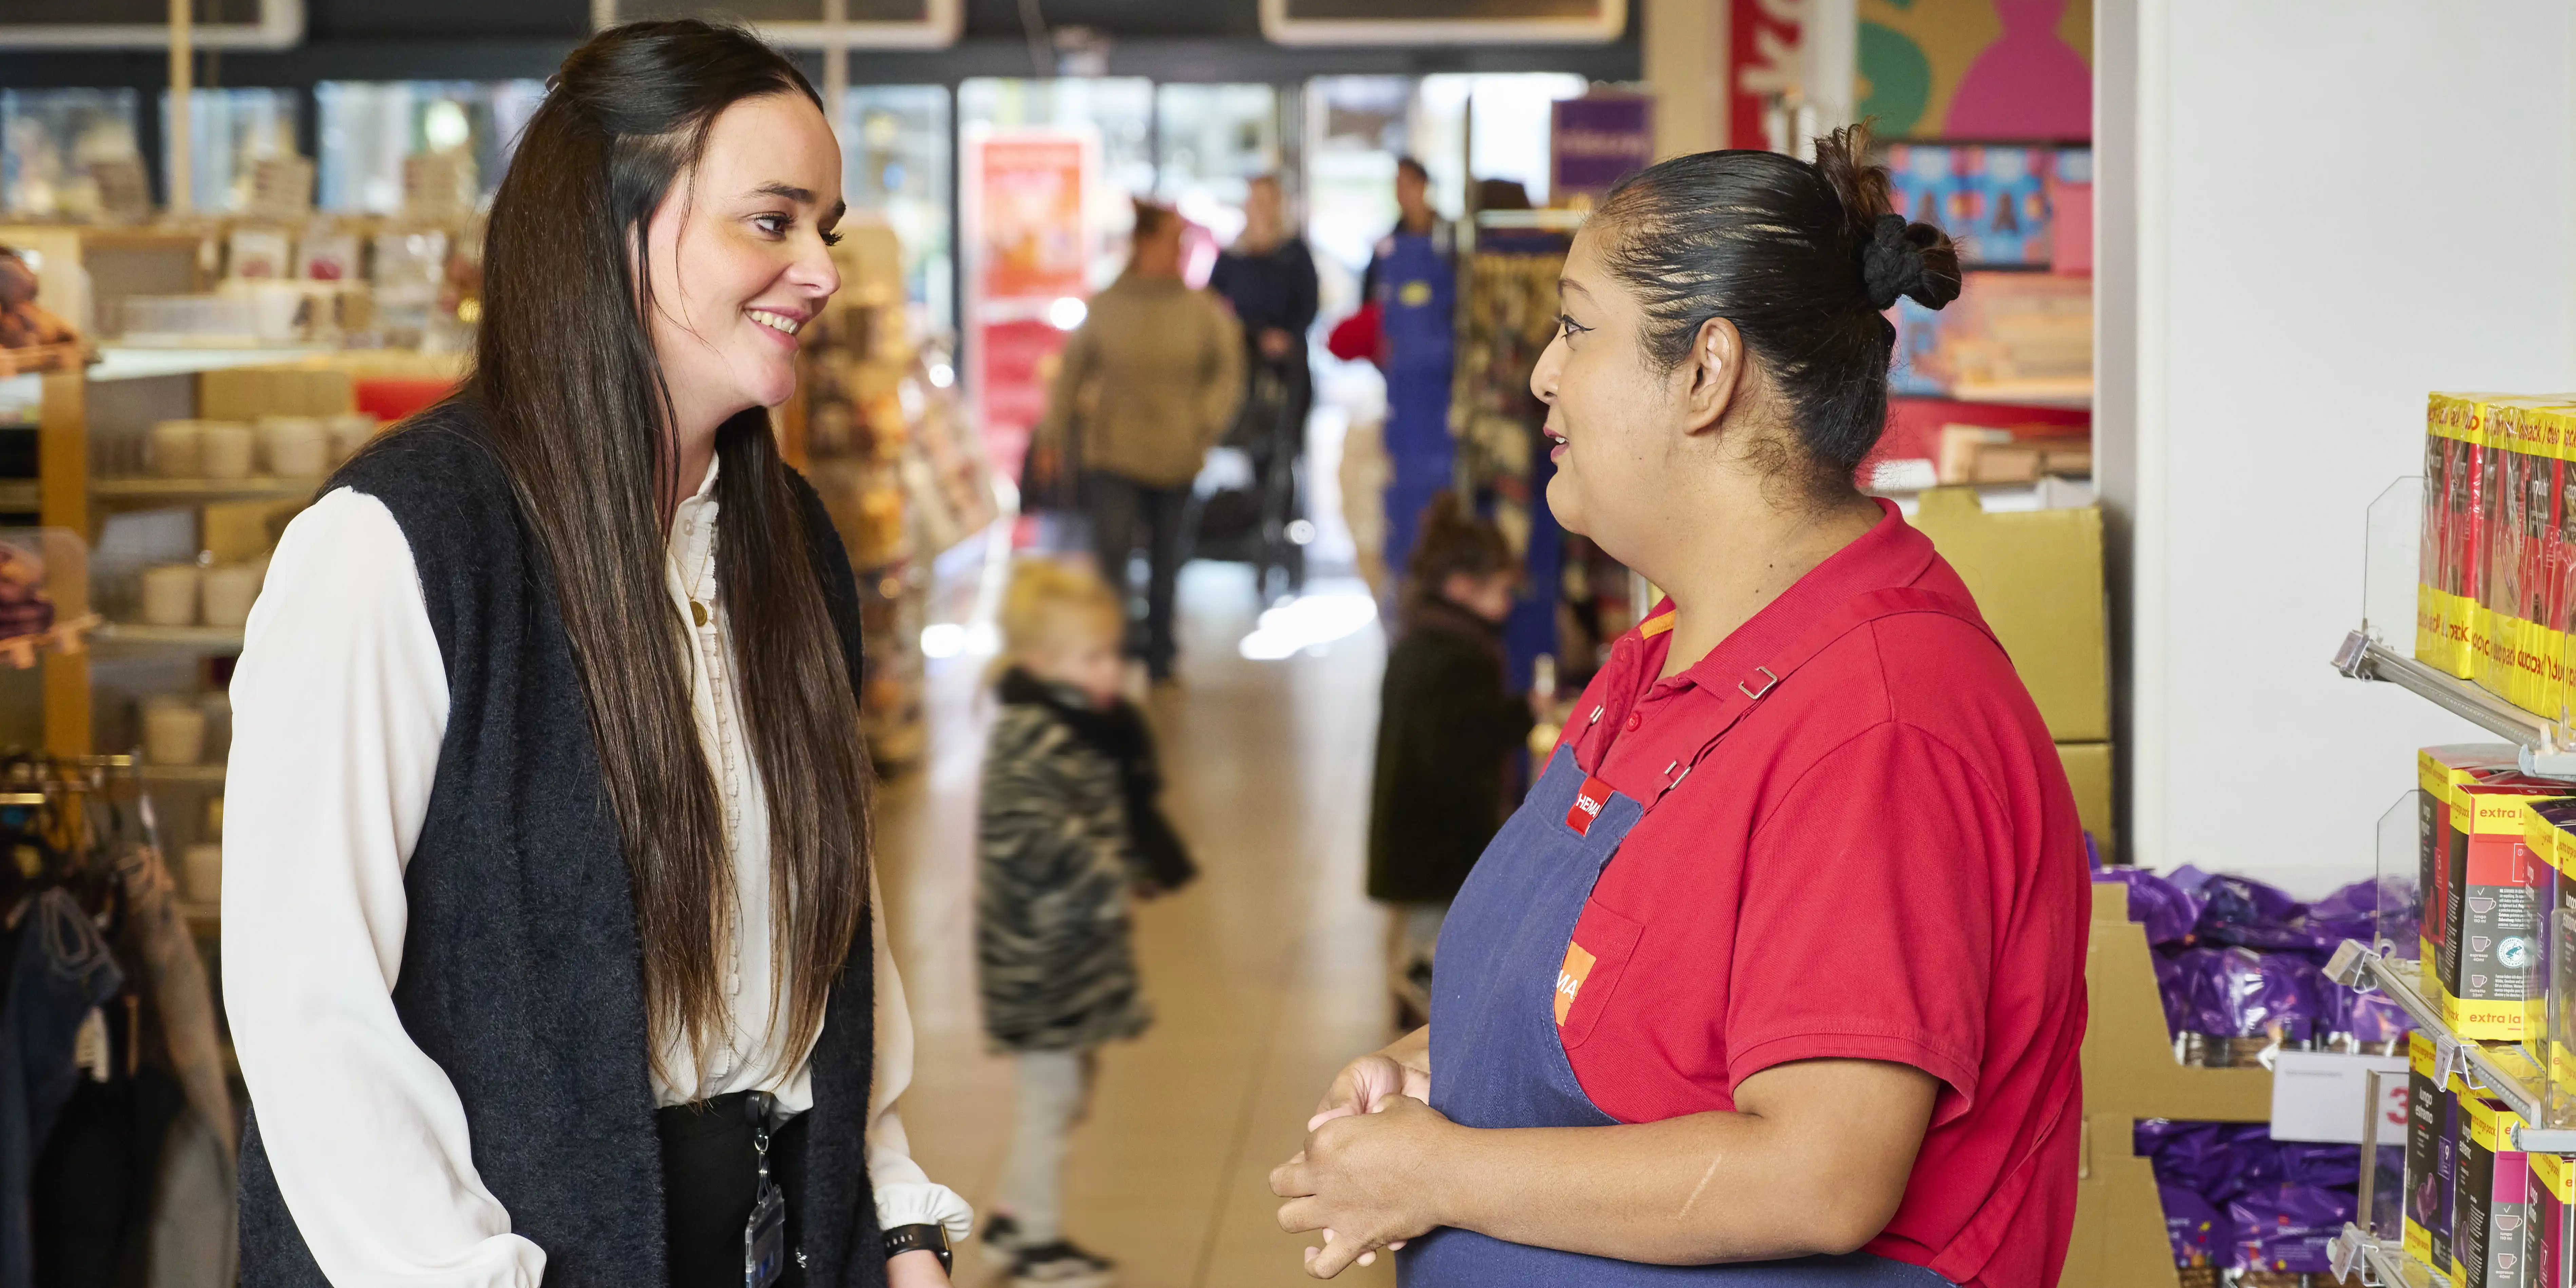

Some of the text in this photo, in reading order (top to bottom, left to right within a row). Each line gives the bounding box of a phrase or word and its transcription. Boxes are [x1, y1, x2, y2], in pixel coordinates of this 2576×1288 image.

[1576, 793, 1601, 818] HEMA
[2480, 808, 2516, 818] extra
[2469, 1013, 2505, 1023] extra
[2419, 1086, 2432, 1108] lungo
[2415, 1104, 2433, 1124] estremo
[2445, 1145, 2449, 1160] 9
